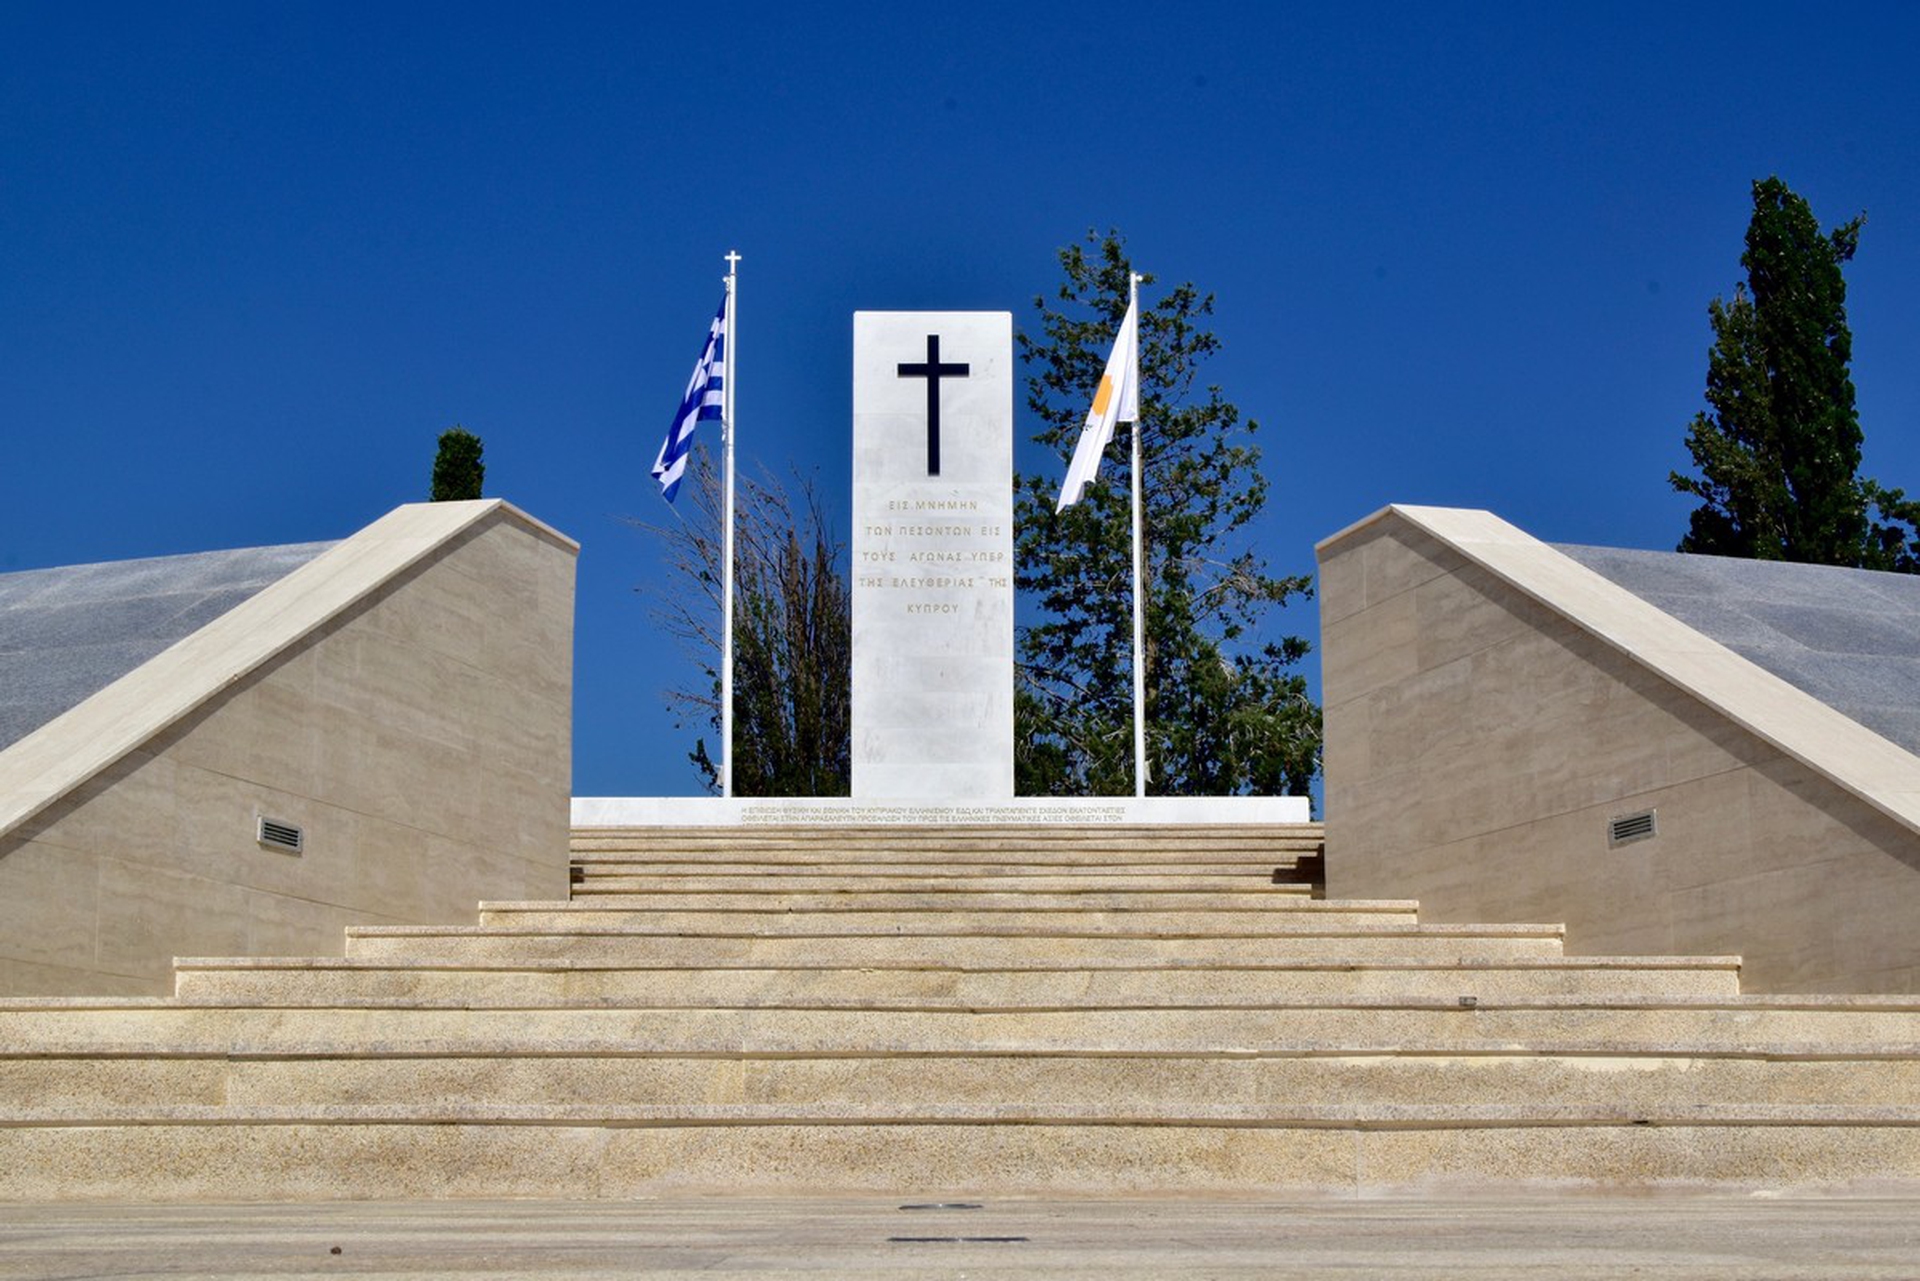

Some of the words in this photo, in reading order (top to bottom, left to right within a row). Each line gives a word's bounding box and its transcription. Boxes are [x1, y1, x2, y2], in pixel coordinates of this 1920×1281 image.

[888, 500, 909, 511] ΕΙΣ
[914, 500, 978, 511] ΜΝΗΜΗΝ
[865, 526, 893, 537] ΤΩΝ
[898, 526, 972, 537] ΠΕΣΟΝΤΩΝ
[980, 526, 1001, 537] ΕΙΣ
[862, 552, 897, 562] ΤΟΥΣ
[909, 552, 962, 562] ΑΓΩΝΑΣ
[971, 552, 1005, 562] ΥΠΕΡ
[859, 577, 884, 588] ΤΗΣ
[892, 577, 975, 588] ΕΛΕΥΘΕΡΙΑΣ
[988, 577, 1008, 588] ΤΗΣ
[906, 604, 960, 614] ΚΥΠΡΟΥ
